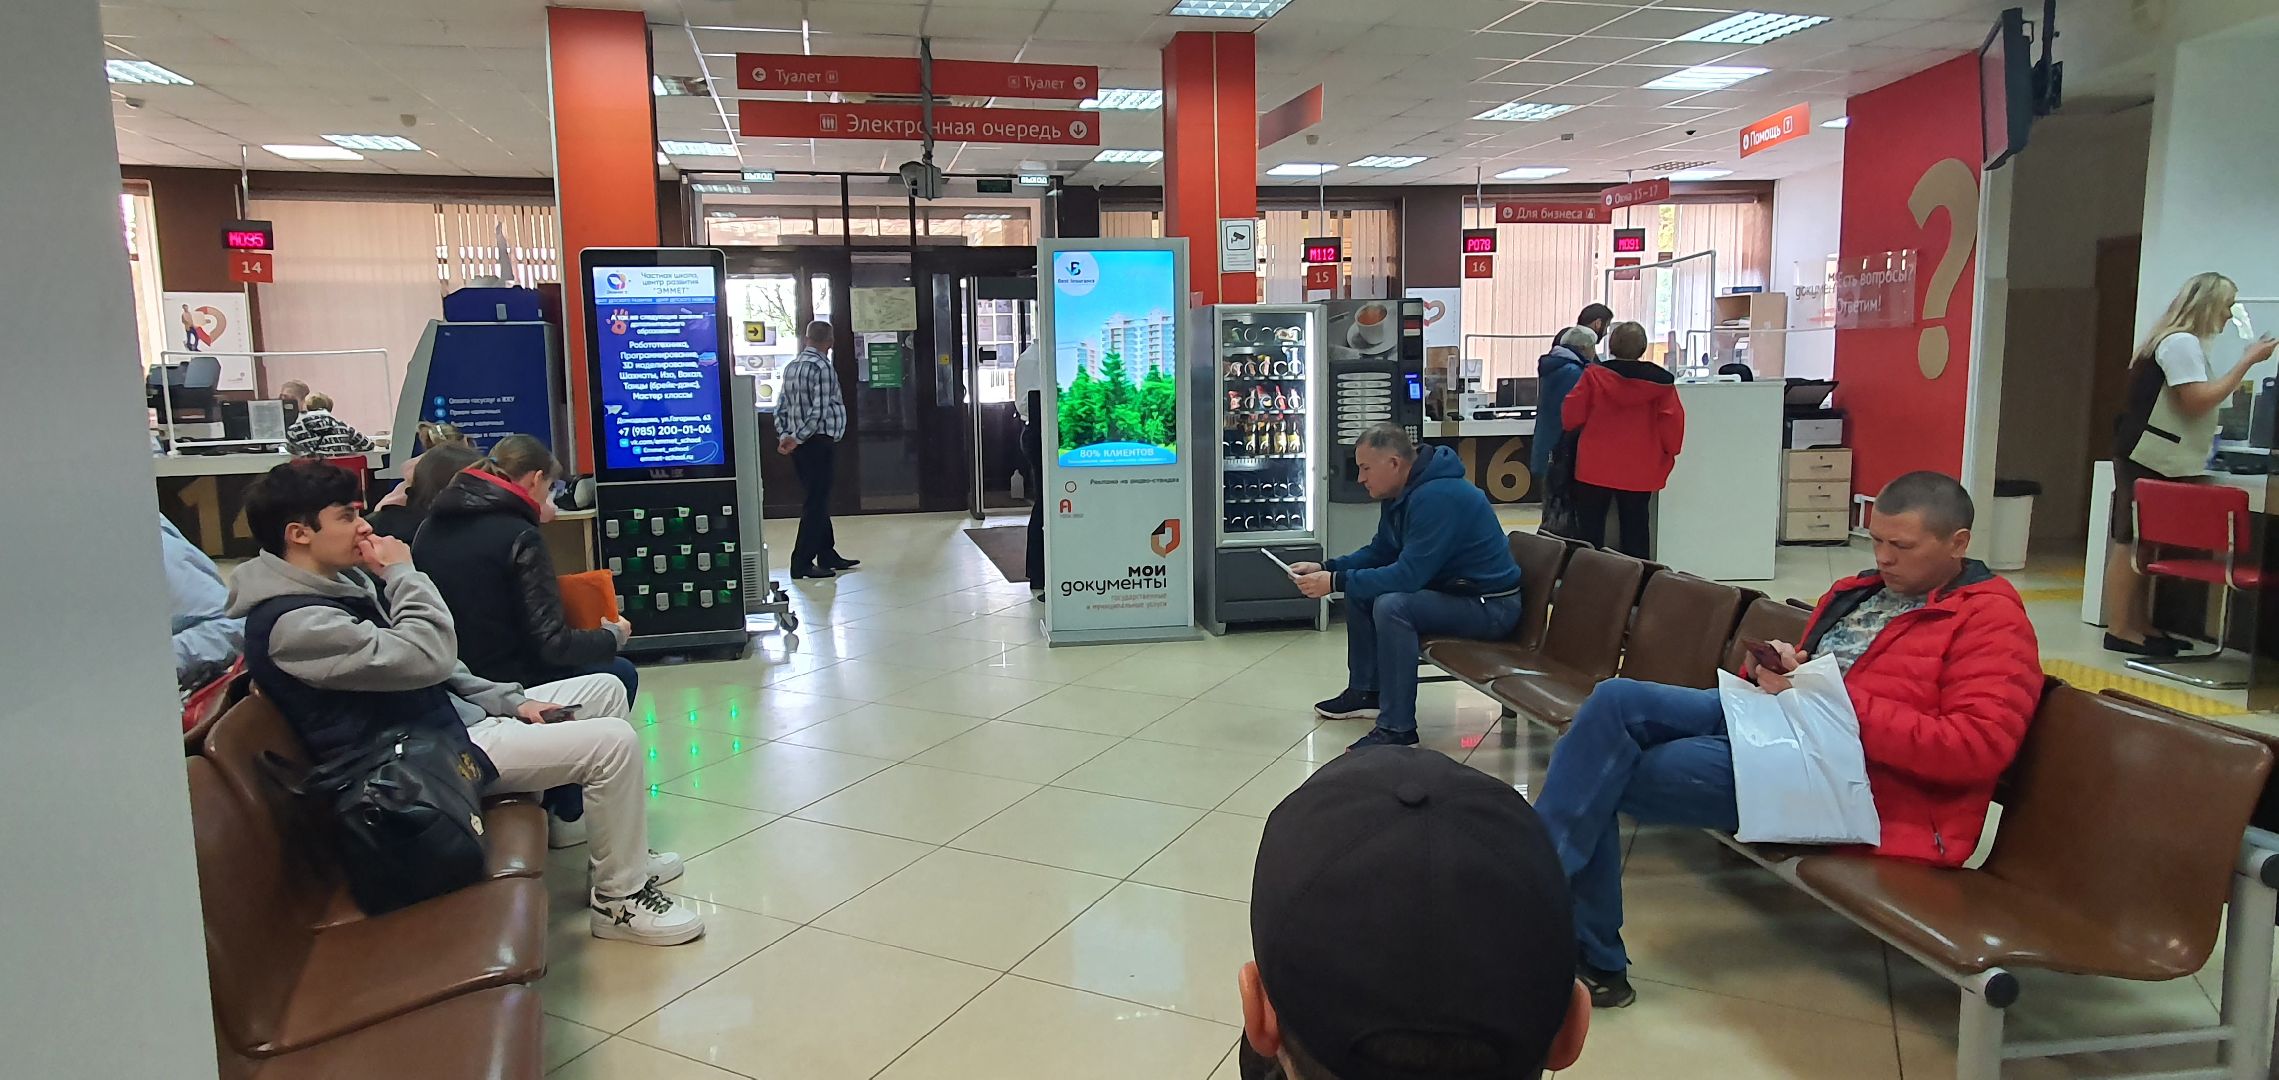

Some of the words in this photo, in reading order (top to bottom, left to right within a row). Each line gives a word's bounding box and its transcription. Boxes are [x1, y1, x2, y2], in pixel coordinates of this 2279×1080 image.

[776, 69, 821, 85] Туалет
[1024, 75, 1065, 90] Туалет
[846, 114, 975, 136] Электронная
[983, 122, 1061, 140] очередь
[1750, 125, 1780, 147] Помощь
[743, 173, 773, 181] ВЫХОД
[1021, 176, 1048, 184] ВЫХОД
[1517, 208, 1538, 220] Для
[1541, 207, 1583, 220] бизнеса
[242, 260, 263, 274] 14
[1472, 261, 1486, 272] 16
[1315, 272, 1329, 283] 15
[1837, 272, 1857, 287] Есть
[1860, 264, 1914, 286] вопросы?
[653, 287, 690, 295] "ЭММЕТ"
[1838, 296, 1882, 314] Ответим!
[619, 372, 659, 380] Шахматы,
[623, 382, 648, 390] Танцы
[633, 392, 663, 400] Мастер
[618, 427, 630, 437] +7
[632, 426, 656, 437] (985)
[658, 425, 712, 435] 200-01-06
[1080, 449, 1101, 458] 80%
[1103, 448, 1154, 457] КЛИЕНТОВ
[1459, 437, 1531, 502] 16
[1129, 565, 1166, 577] мои
[1061, 578, 1167, 597] документы
